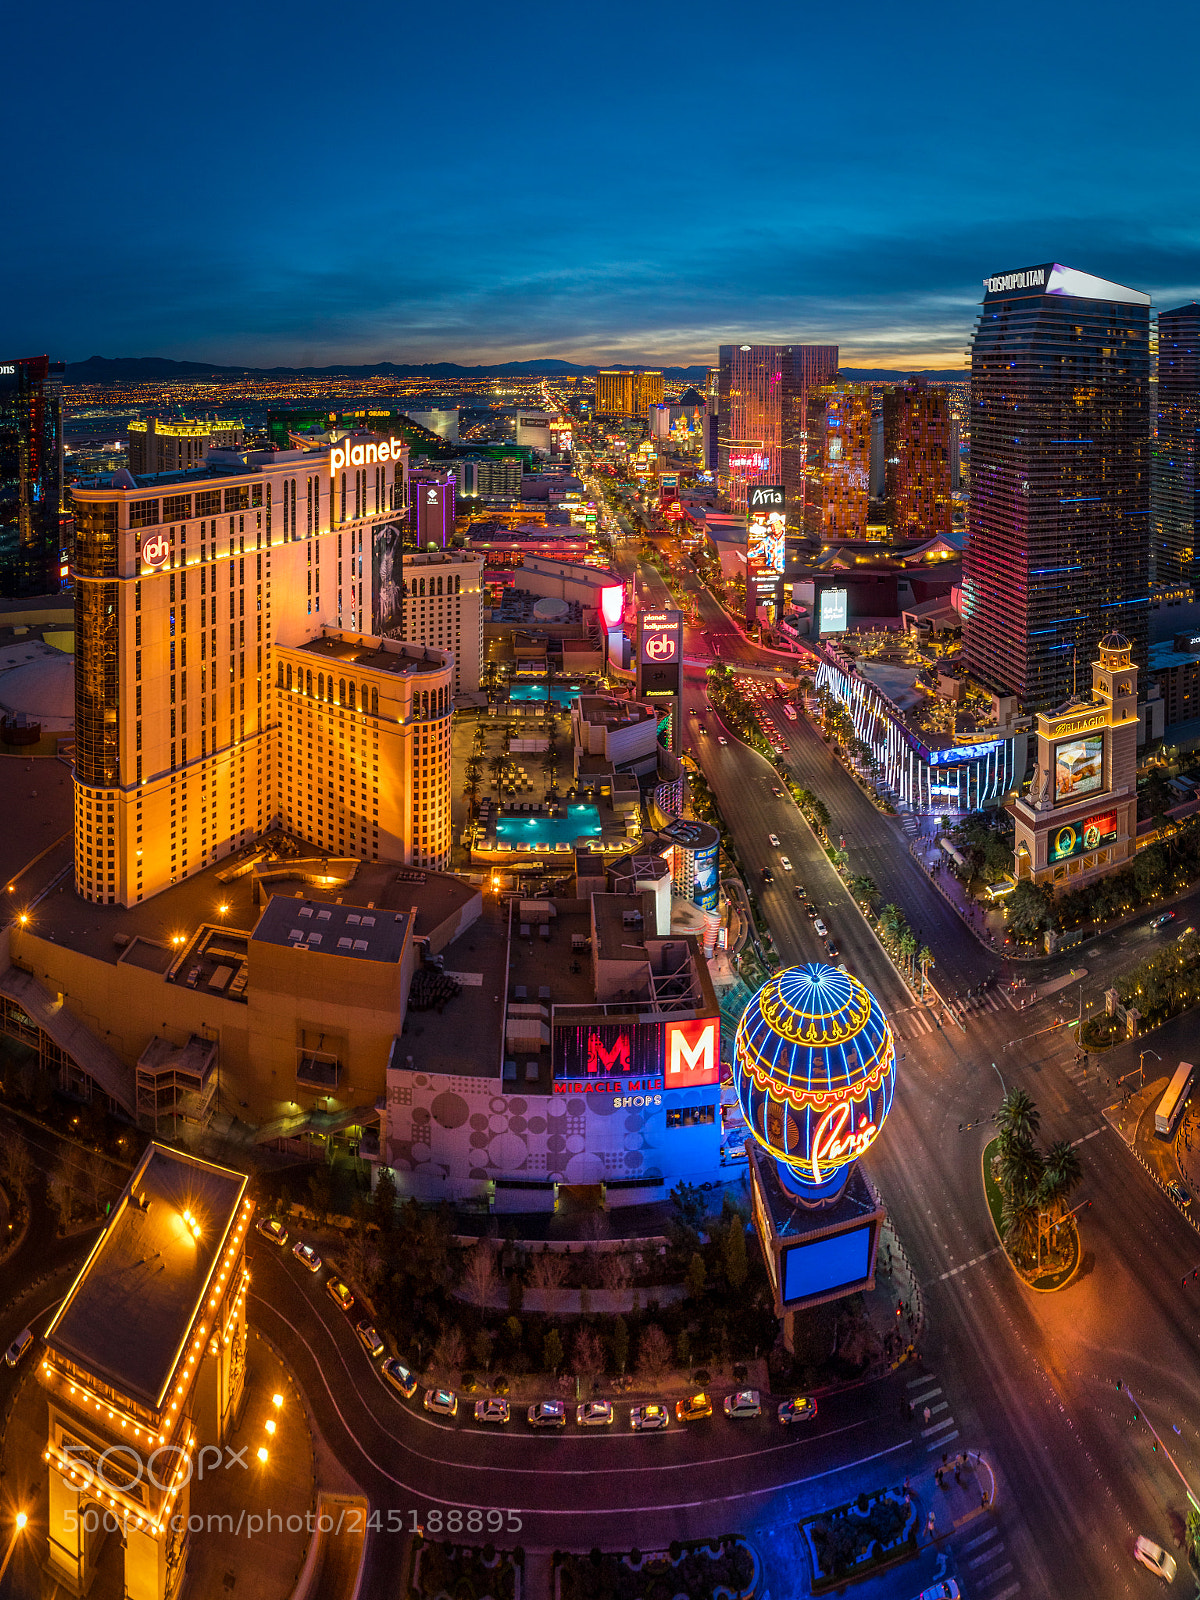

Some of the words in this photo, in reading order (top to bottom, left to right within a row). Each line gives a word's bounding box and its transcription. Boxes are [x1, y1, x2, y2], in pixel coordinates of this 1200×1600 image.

[988, 269, 1045, 293] COSMOPOLITAN
[549, 422, 572, 430] MGM
[330, 436, 402, 478] planet
[752, 488, 782, 505] Aria
[145, 535, 169, 564] ph
[643, 614, 667, 623] planet
[643, 622, 678, 631] hollywood
[648, 633, 675, 659] ph
[1052, 715, 1105, 736] BELLAGIO
[587, 1033, 631, 1073] M
[670, 1025, 715, 1073] M
[554, 1082, 622, 1094] MIRACLE
[628, 1079, 662, 1092] MILE
[613, 1095, 662, 1109] SHOPS
[812, 1102, 877, 1184] Paris
